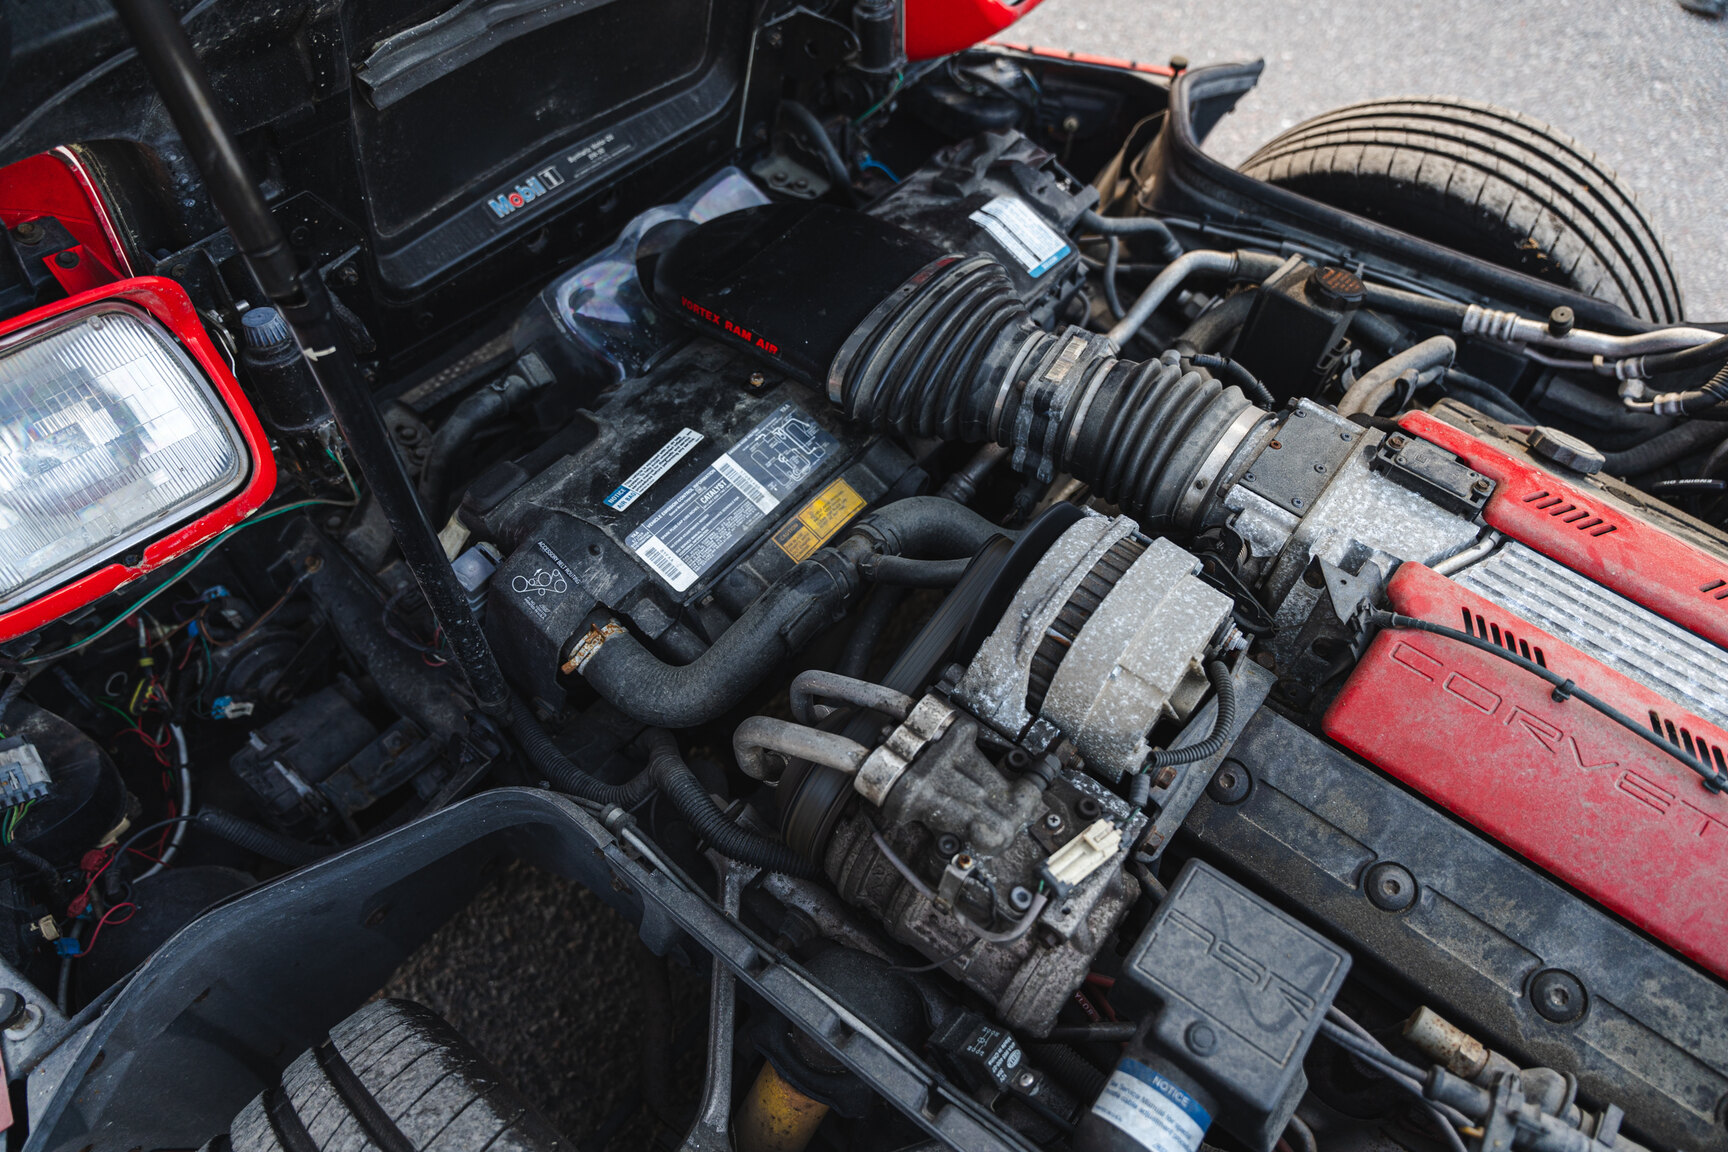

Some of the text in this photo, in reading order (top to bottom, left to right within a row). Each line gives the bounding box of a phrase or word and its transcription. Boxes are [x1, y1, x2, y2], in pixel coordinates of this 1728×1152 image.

[488, 176, 546, 218] Mobil
[682, 296, 778, 354] VORTEX RAM AIR
[607, 487, 626, 503] NOTICE
[616, 492, 636, 508] AIR BAG
[645, 514, 662, 528] VEHICLE
[660, 500, 678, 516] EMISSION
[676, 487, 694, 502] CONTROL
[692, 468, 716, 489] INFORMATION
[699, 479, 727, 504] CATALYST
[538, 541, 580, 584] ACCESSORY BELT ROUTING
[1152, 1075, 1190, 1108] NOTICE
